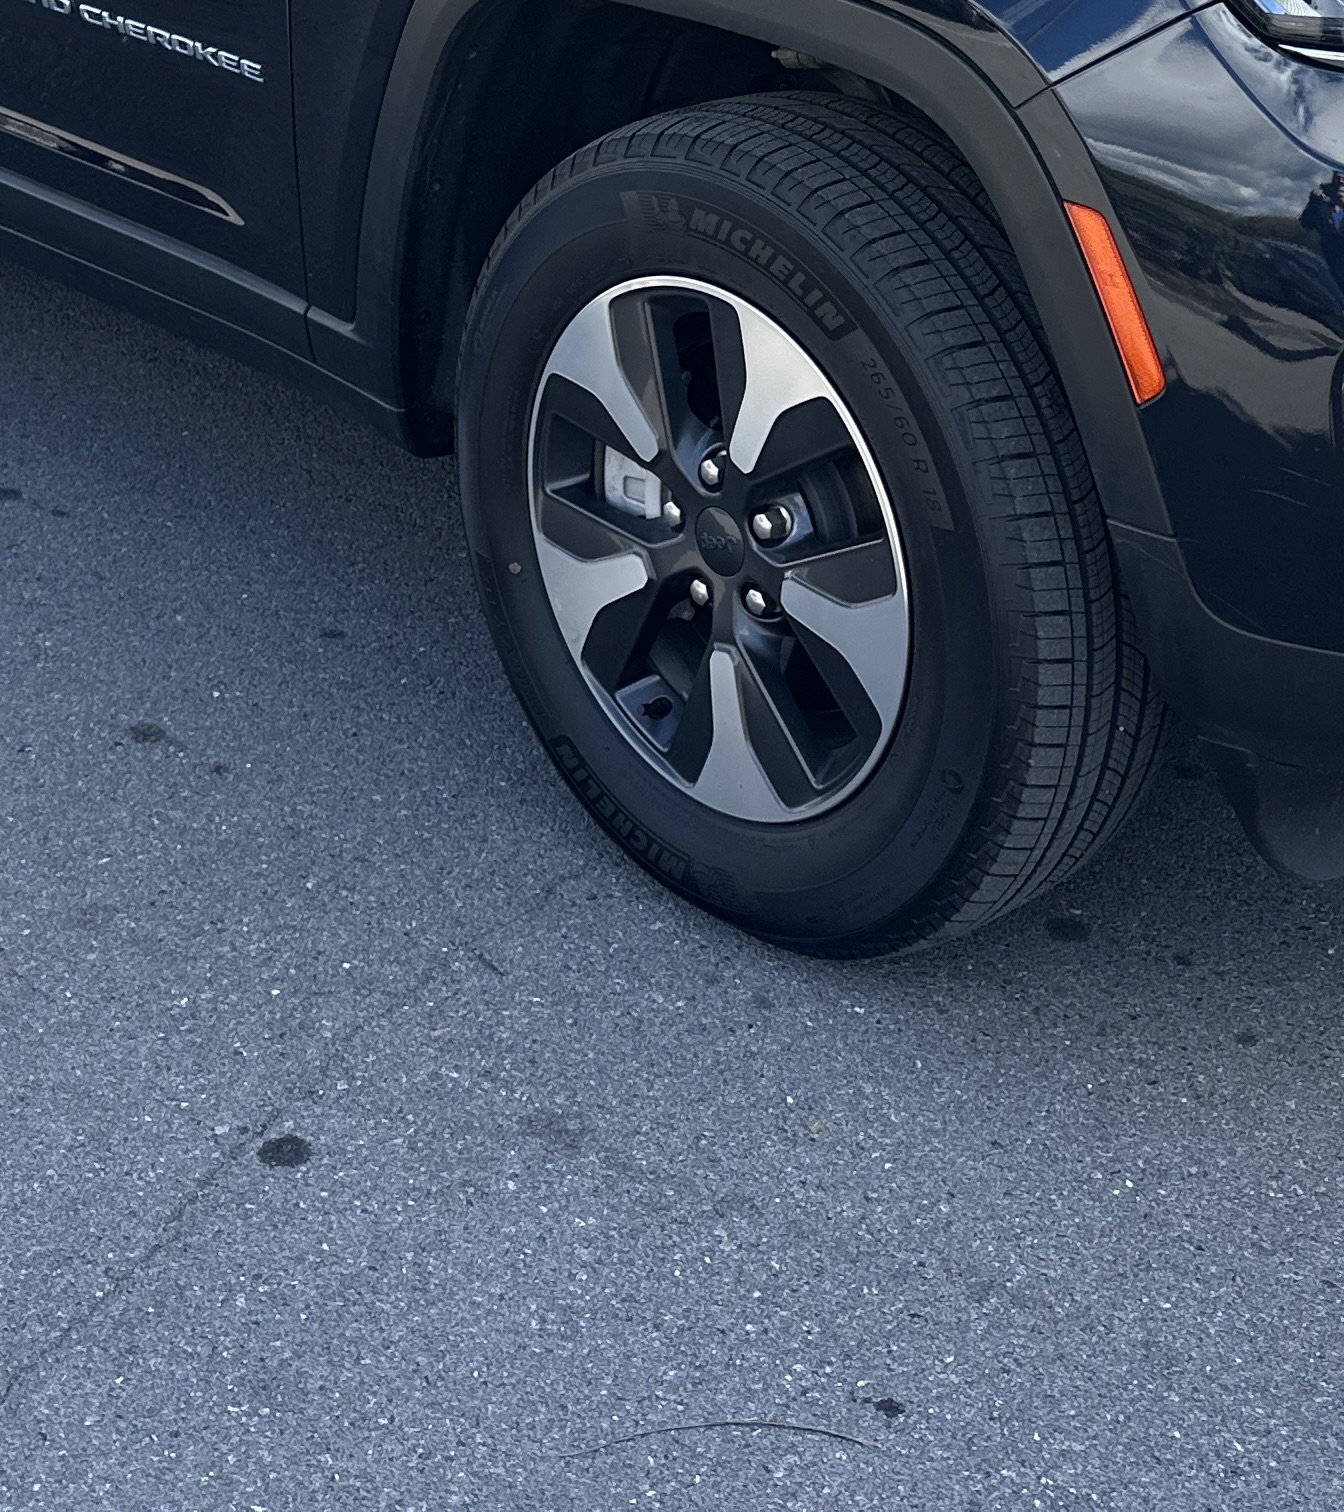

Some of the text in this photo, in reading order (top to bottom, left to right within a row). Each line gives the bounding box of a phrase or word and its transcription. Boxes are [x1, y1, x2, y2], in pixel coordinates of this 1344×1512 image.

[79, 4, 264, 83] CHEROKEE
[689, 208, 846, 331] MICHELIN
[860, 357, 918, 448] 265/60
[555, 742, 687, 881] MICHELIN
